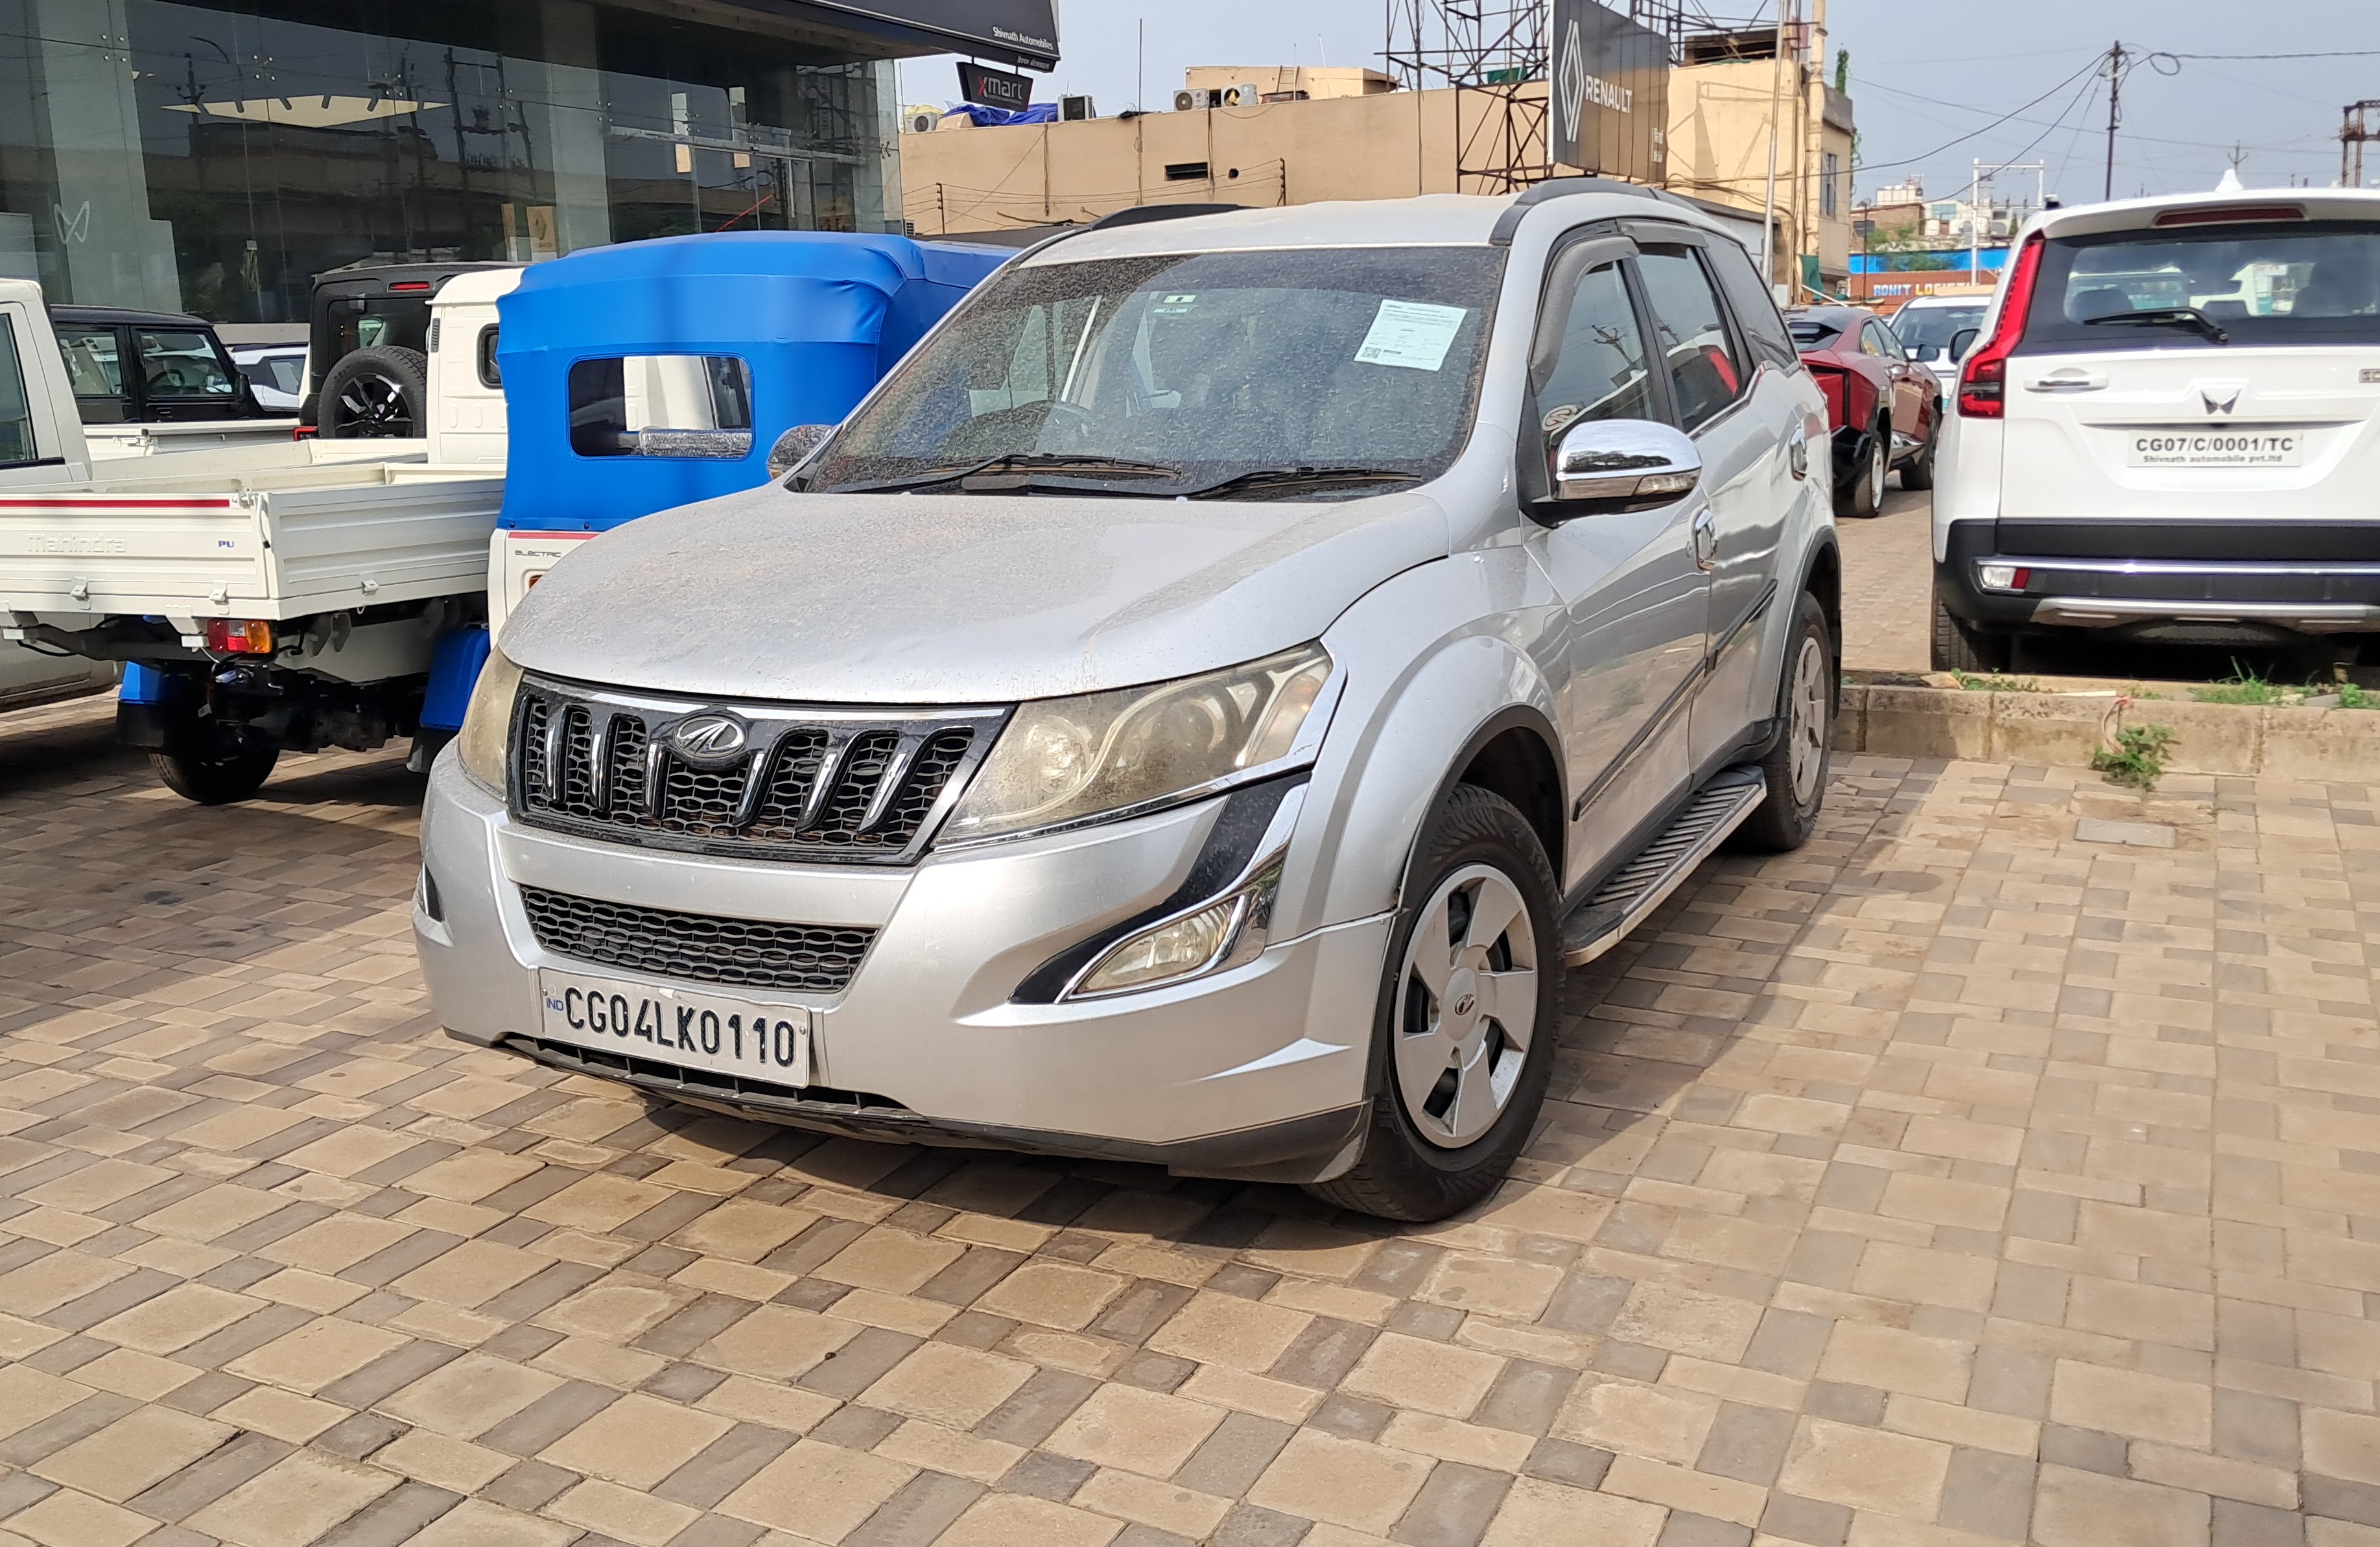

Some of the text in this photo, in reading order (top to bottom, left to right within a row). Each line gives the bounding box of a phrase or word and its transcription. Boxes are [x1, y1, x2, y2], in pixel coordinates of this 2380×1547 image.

[1019, 32, 1054, 50] Automobiles
[1585, 75, 1632, 113] RENAULT
[2136, 438, 2294, 452] CG07/C/0001/TC
[546, 997, 564, 1011] IND
[565, 986, 795, 1067] CG04LK0110
